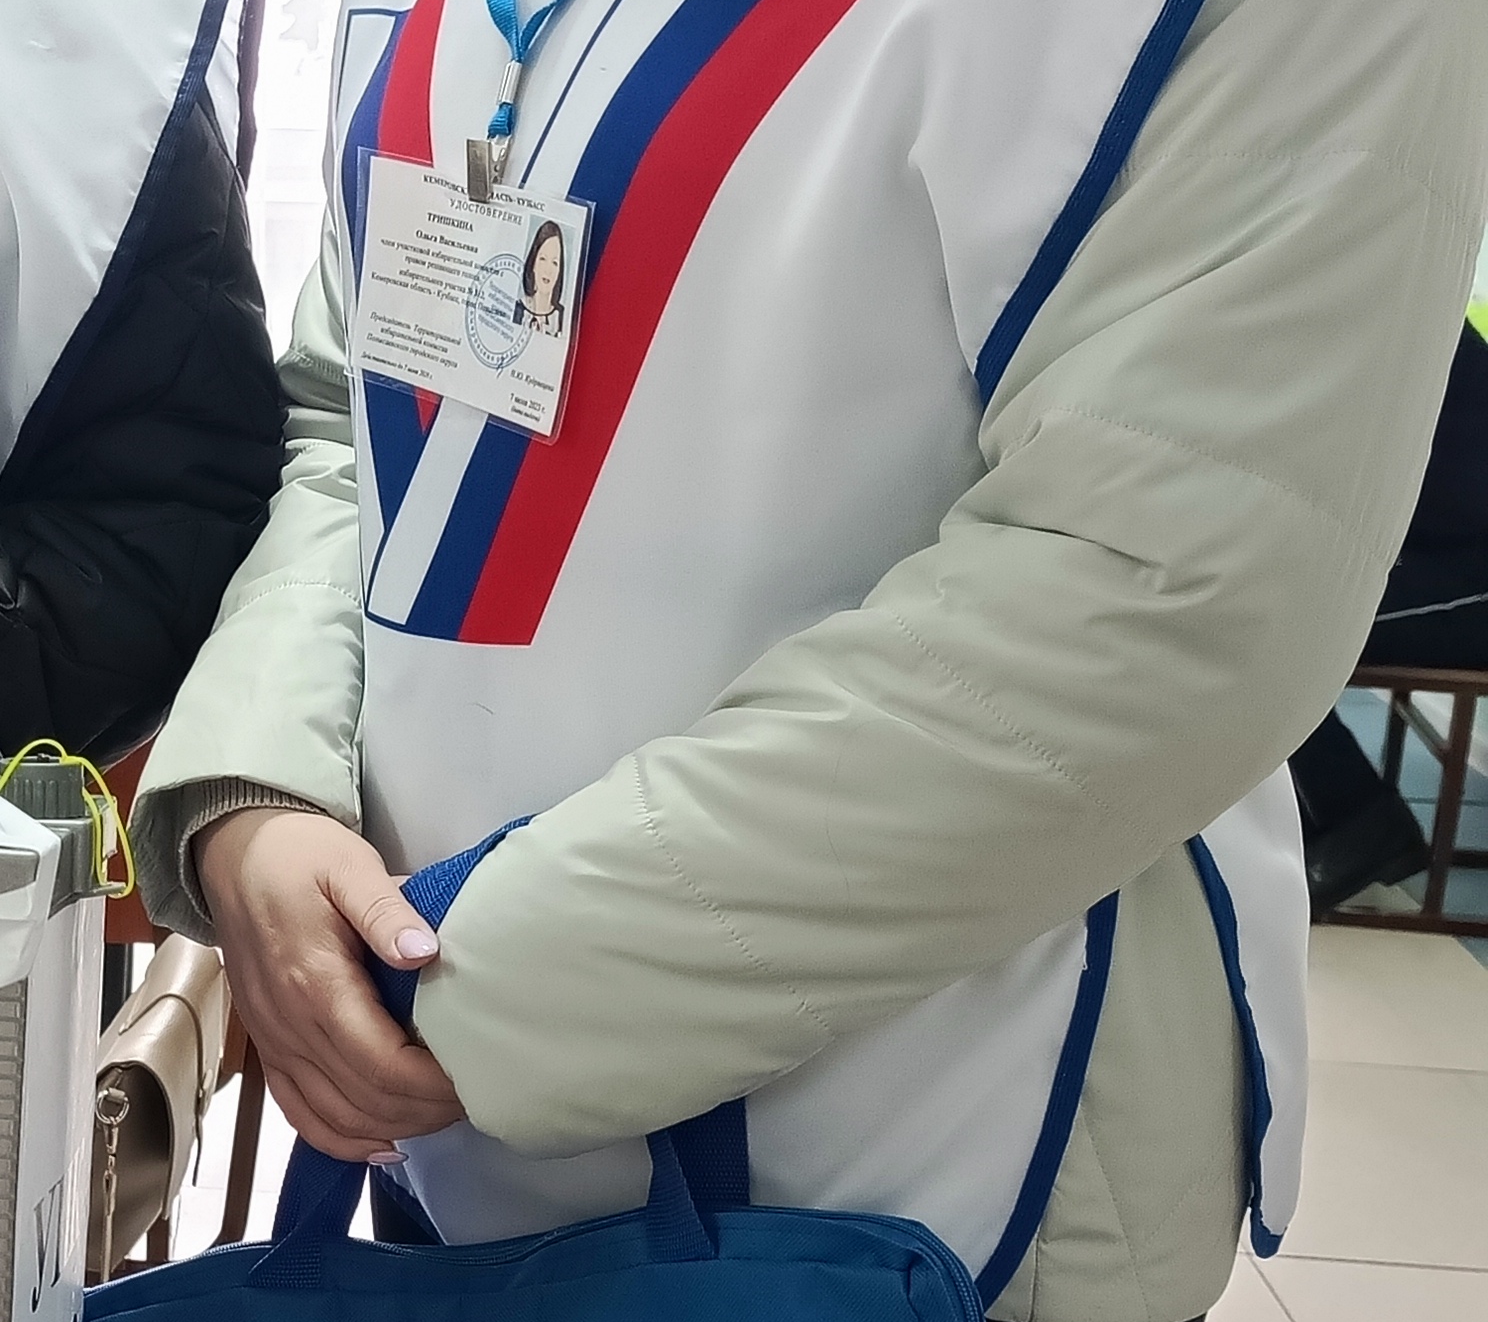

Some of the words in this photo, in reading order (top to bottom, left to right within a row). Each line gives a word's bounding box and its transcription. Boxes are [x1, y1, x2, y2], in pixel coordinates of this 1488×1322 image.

[422, 173, 468, 194] КЕМЕРОВСК
[426, 211, 473, 232] ТРИШКИНА
[449, 197, 522, 226] УДОСТОВЕРЕНИЕ
[415, 228, 437, 243] Ольга
[438, 235, 478, 254] Васильевна
